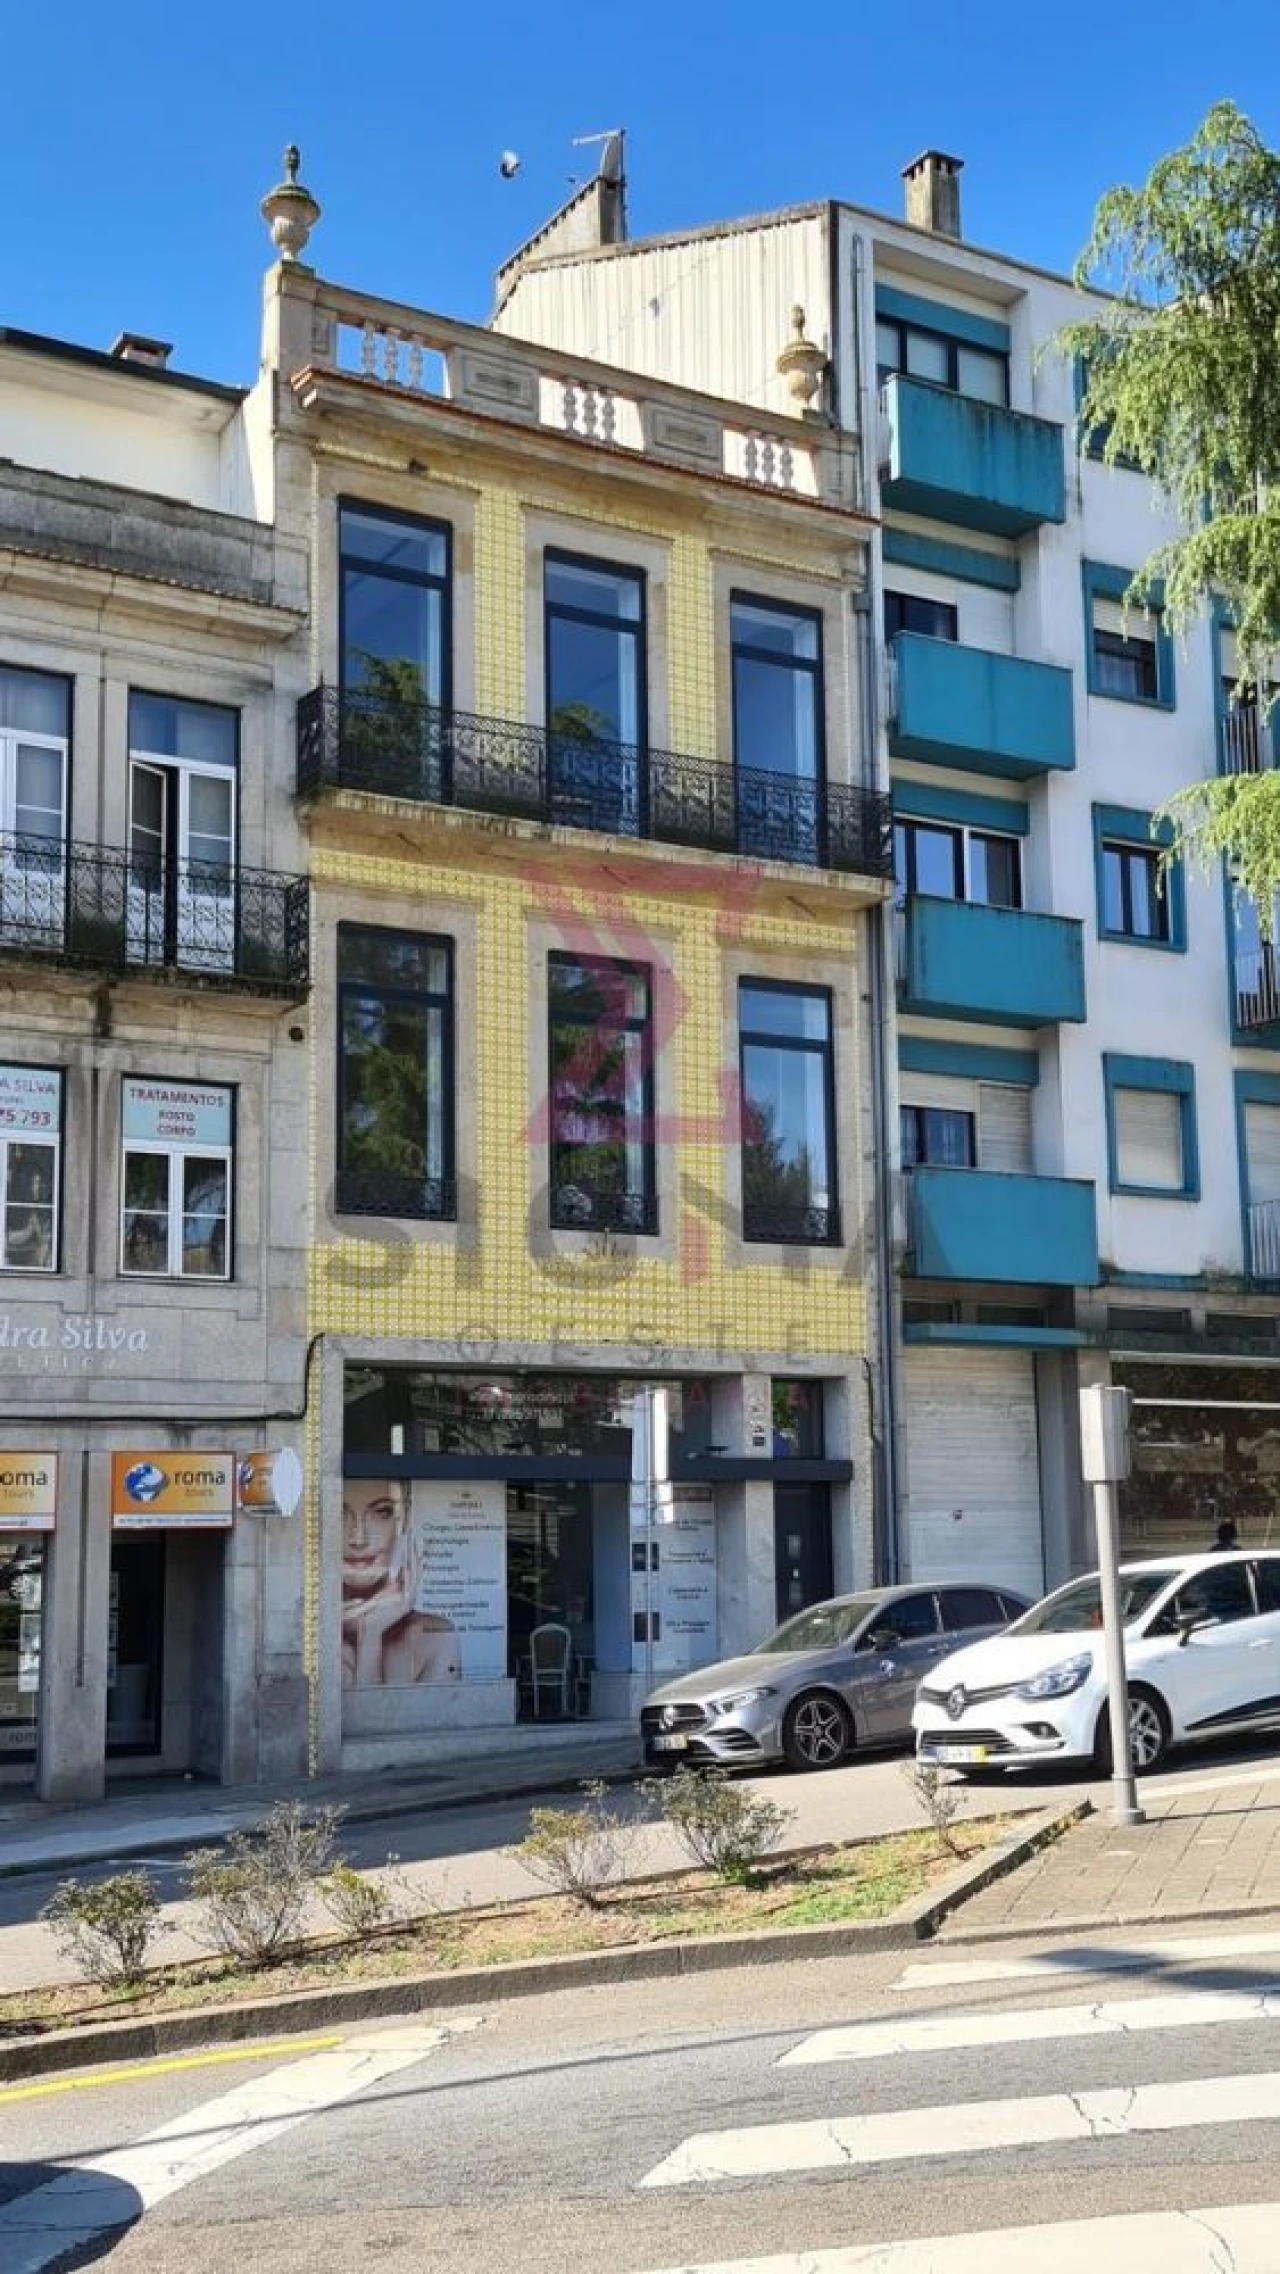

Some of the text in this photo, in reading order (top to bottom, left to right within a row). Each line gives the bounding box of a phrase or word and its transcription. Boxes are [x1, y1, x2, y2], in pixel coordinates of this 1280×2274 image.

[129, 1087, 224, 1107] TRATAMENTOS
[158, 1110, 196, 1121] ROSTO
[60, 1312, 147, 1351] Silva
[174, 1470, 226, 1486] roma
